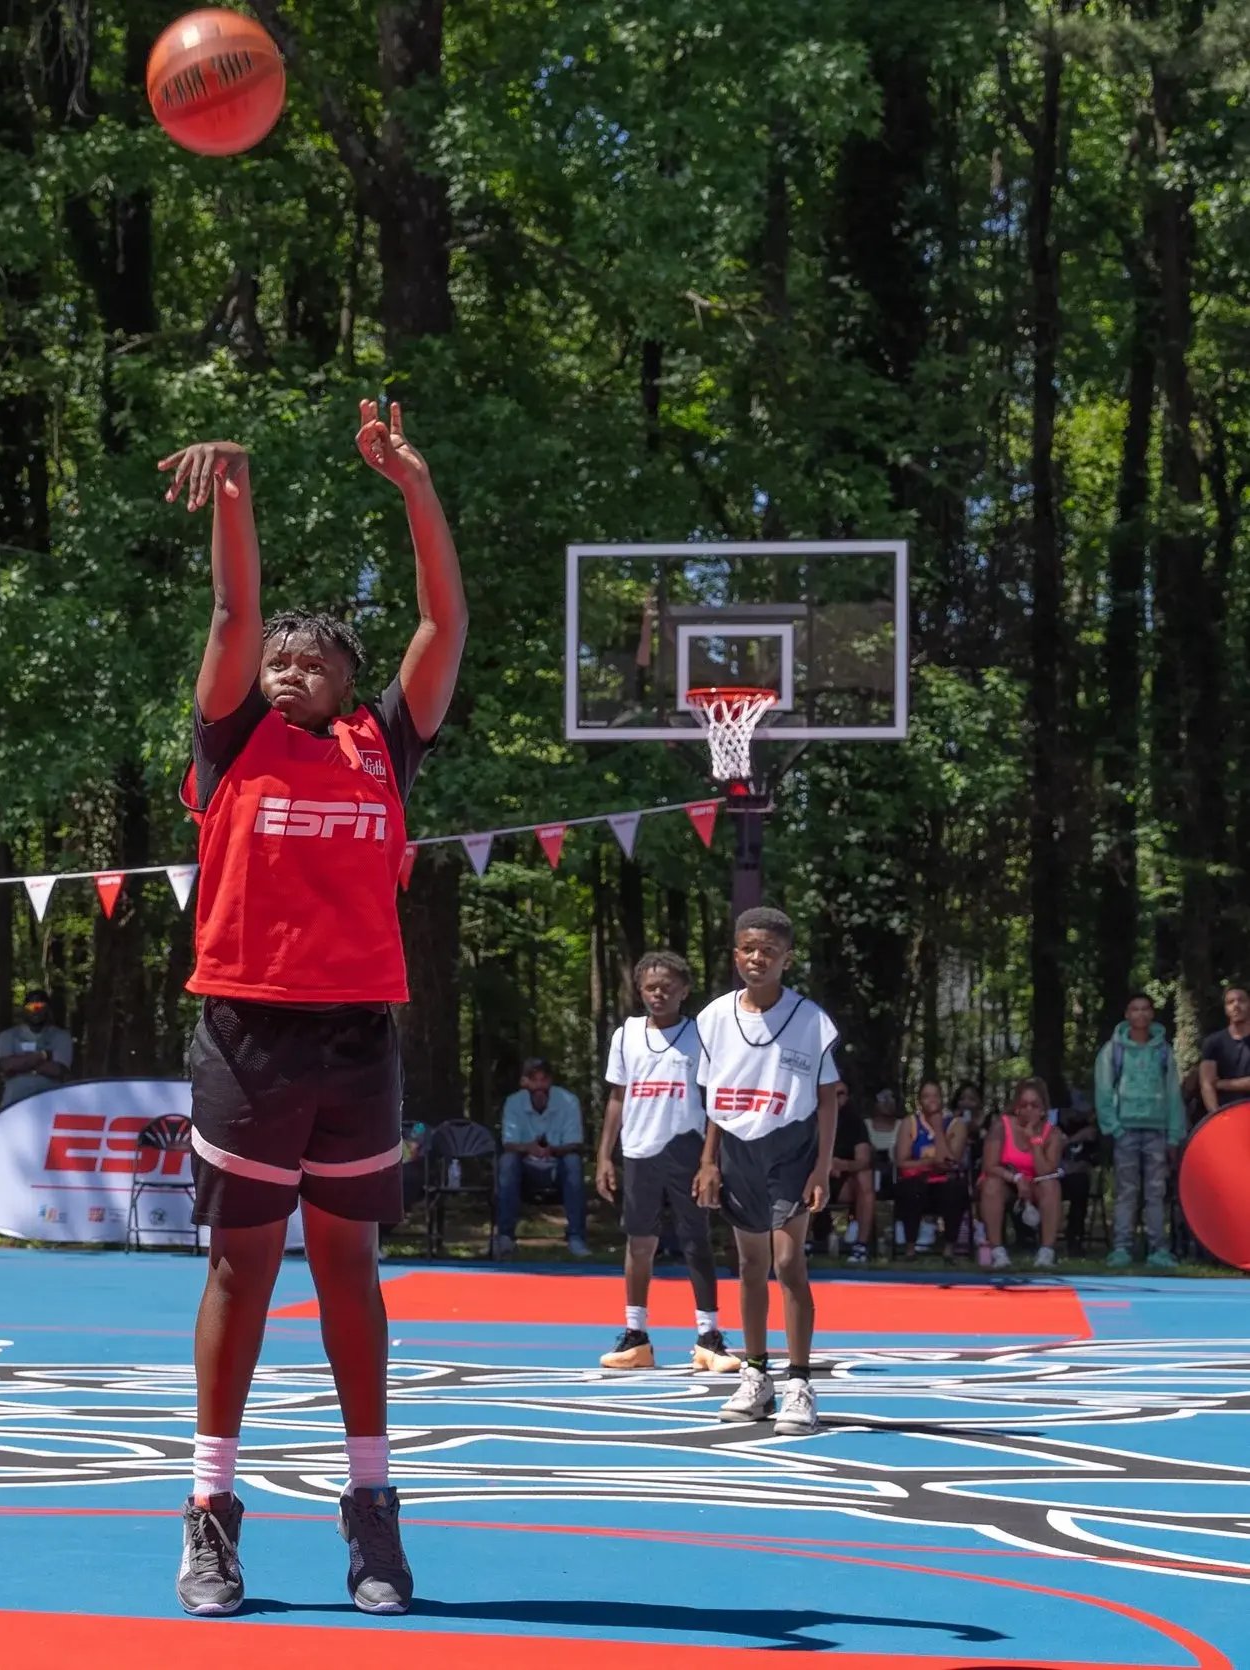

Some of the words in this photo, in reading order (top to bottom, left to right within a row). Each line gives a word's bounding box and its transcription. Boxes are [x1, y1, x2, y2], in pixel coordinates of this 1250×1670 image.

[253, 796, 387, 840] ESPN
[632, 1080, 685, 1098] ESPN
[715, 1087, 787, 1115] ESPN
